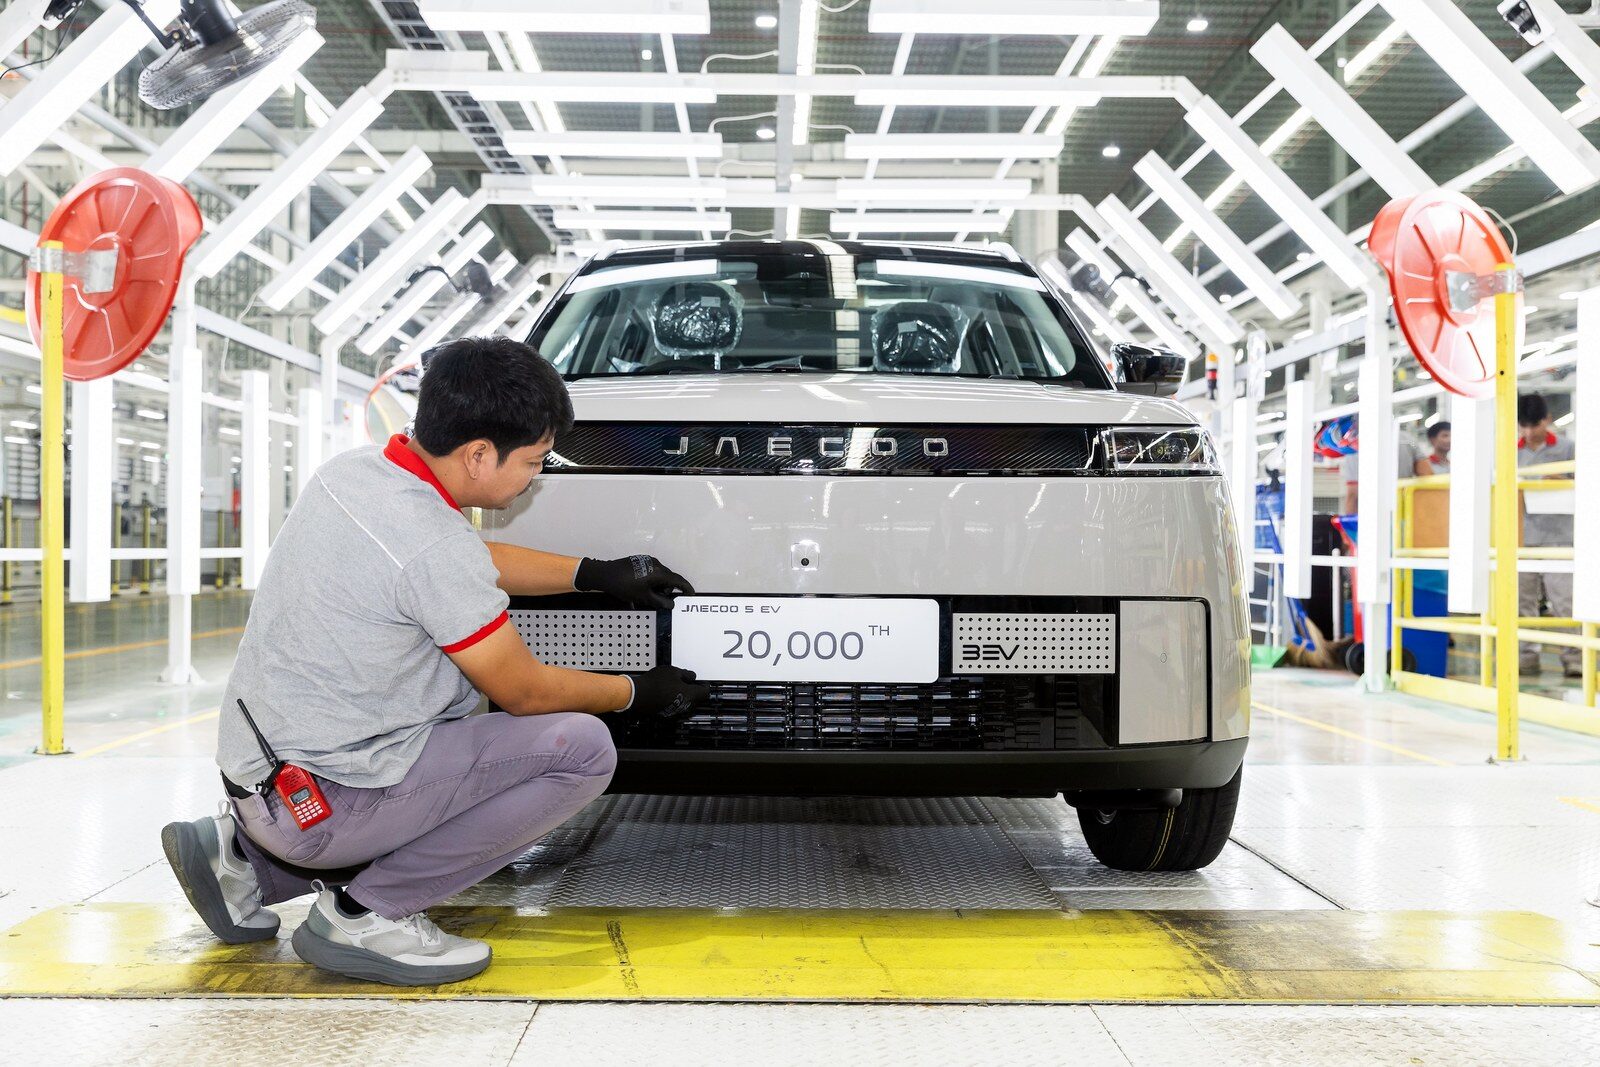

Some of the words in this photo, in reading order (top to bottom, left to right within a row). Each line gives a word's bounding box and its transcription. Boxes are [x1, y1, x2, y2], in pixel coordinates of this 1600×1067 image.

[663, 436, 949, 456] JAECOO
[681, 604, 739, 613] JAECOO
[760, 605, 781, 614] EV
[722, 630, 864, 666] 20,000
[868, 625, 890, 636] TH
[962, 644, 1020, 660] BEV
